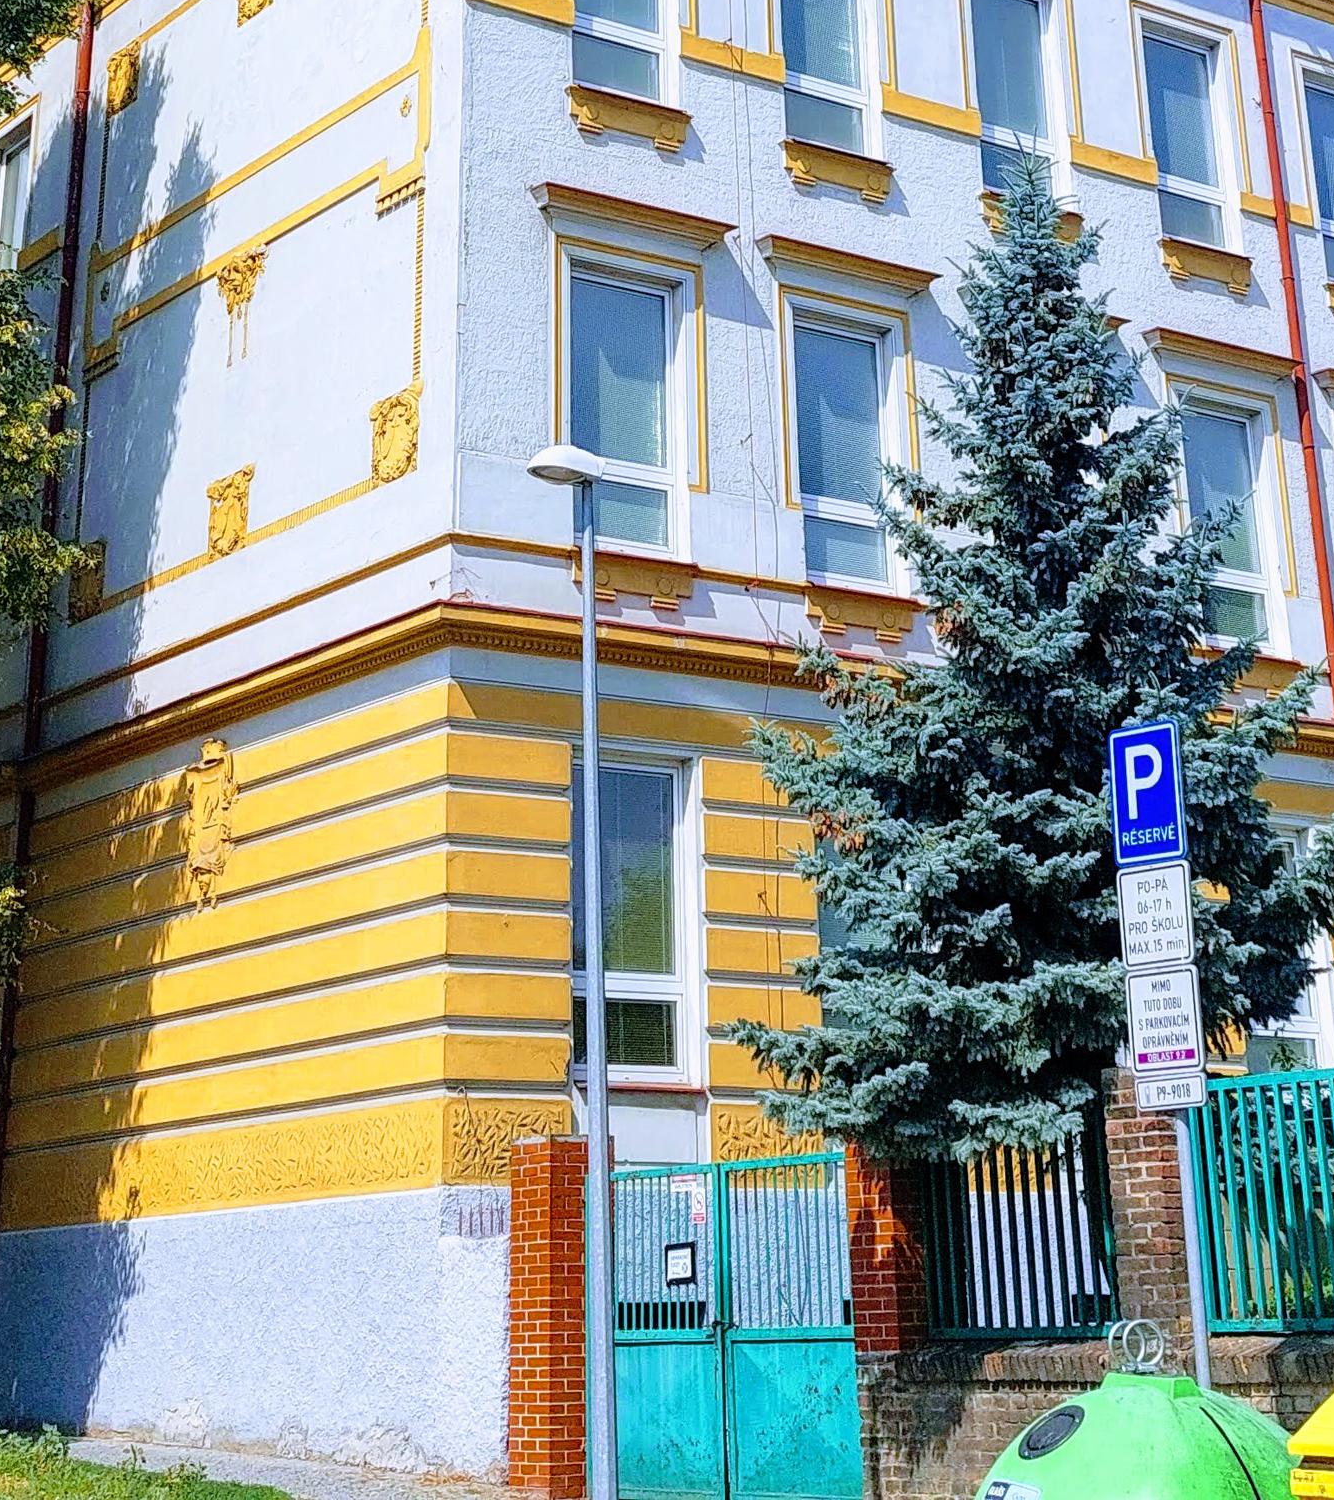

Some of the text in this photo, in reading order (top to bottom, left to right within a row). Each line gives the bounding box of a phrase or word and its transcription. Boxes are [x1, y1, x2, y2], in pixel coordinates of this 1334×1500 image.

[1124, 742, 1163, 820] P
[1122, 823, 1177, 846] RÉSERVÉ
[1137, 875, 1169, 894] PO-PÁ
[1137, 898, 1172, 914] 06-17 h
[1128, 915, 1184, 935] PRO ŠKOLU
[1151, 979, 1171, 993] MIMO
[1143, 996, 1182, 1013] TUTO DOBU
[1138, 1013, 1190, 1031] S PARKOVACÍM
[1142, 1031, 1189, 1049] OPRÁVNĚNÍM
[1147, 1051, 1174, 1063] OBLAST
[1156, 1082, 1191, 1102] P9-9018
